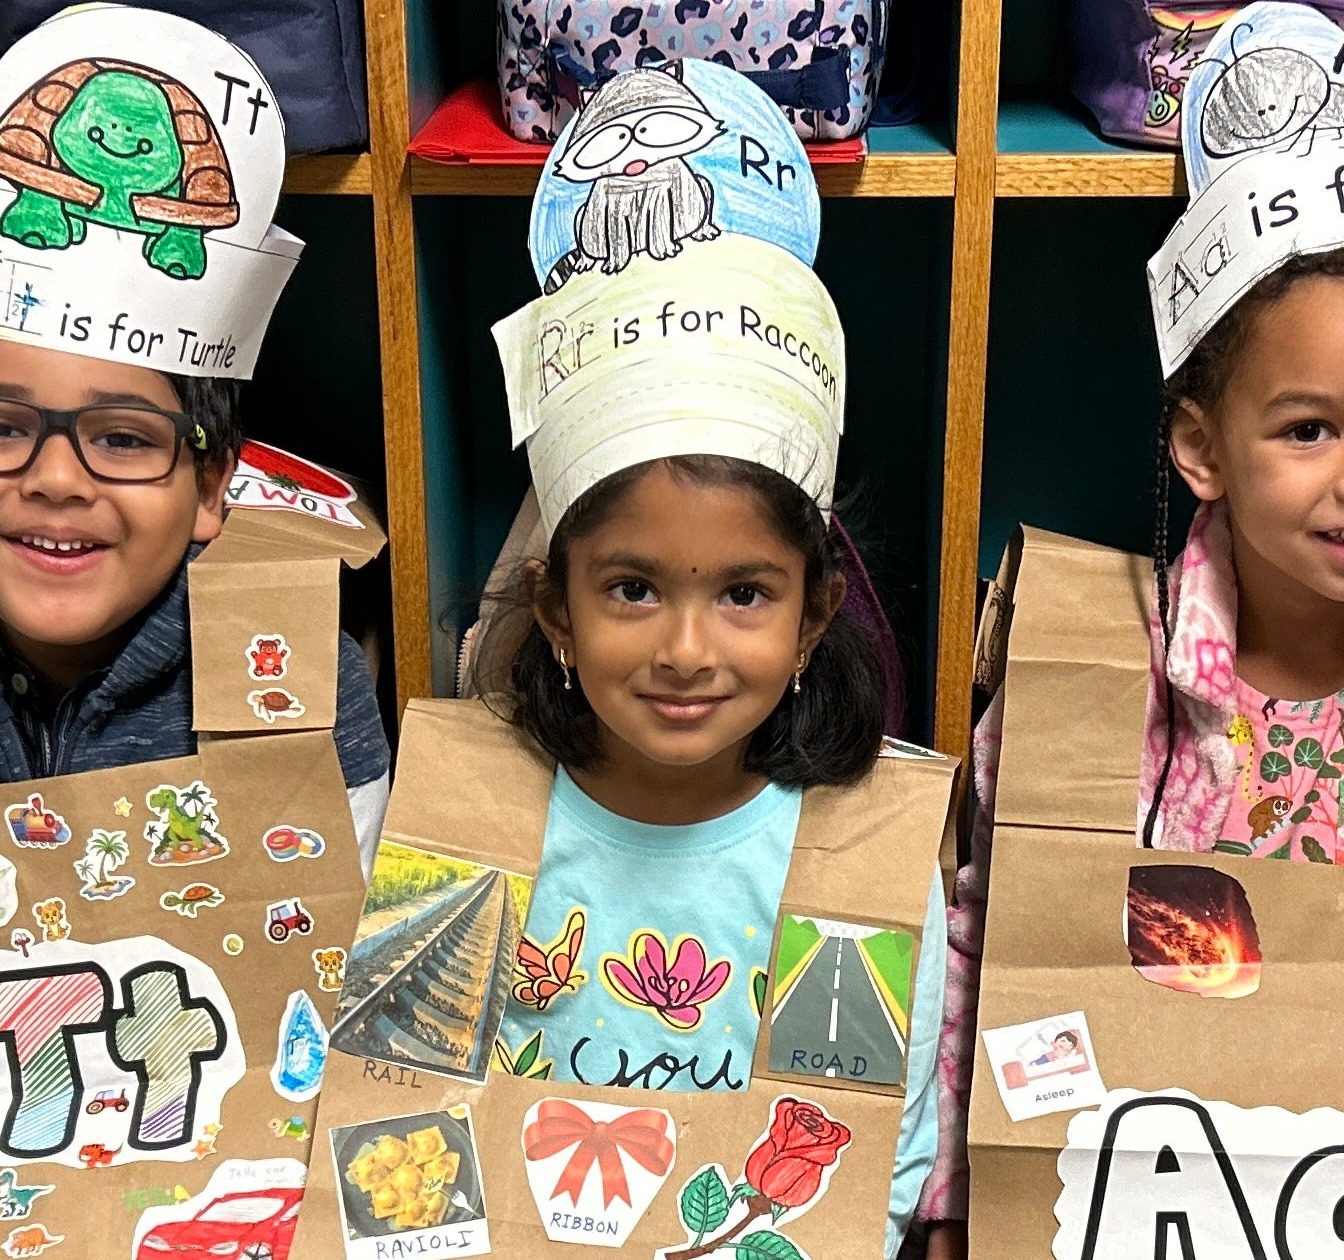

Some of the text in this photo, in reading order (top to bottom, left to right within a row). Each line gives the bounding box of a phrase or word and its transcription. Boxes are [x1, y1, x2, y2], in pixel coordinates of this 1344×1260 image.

[214, 70, 269, 135] Tt
[739, 134, 796, 192] Rr
[1247, 188, 1299, 237] is
[60, 303, 92, 342] is
[108, 312, 164, 358] for
[177, 327, 237, 369] Turtle
[613, 317, 641, 349] is
[656, 301, 724, 337] for
[740, 305, 837, 403] Raccoon
[228, 480, 353, 525] TOMA
[362, 1060, 423, 1089] RAIL
[791, 1049, 868, 1077] ROAD
[1034, 1086, 1075, 1104] Asleep
[376, 1229, 474, 1260] RAVIOLI
[550, 1211, 619, 1236] RIBBON
